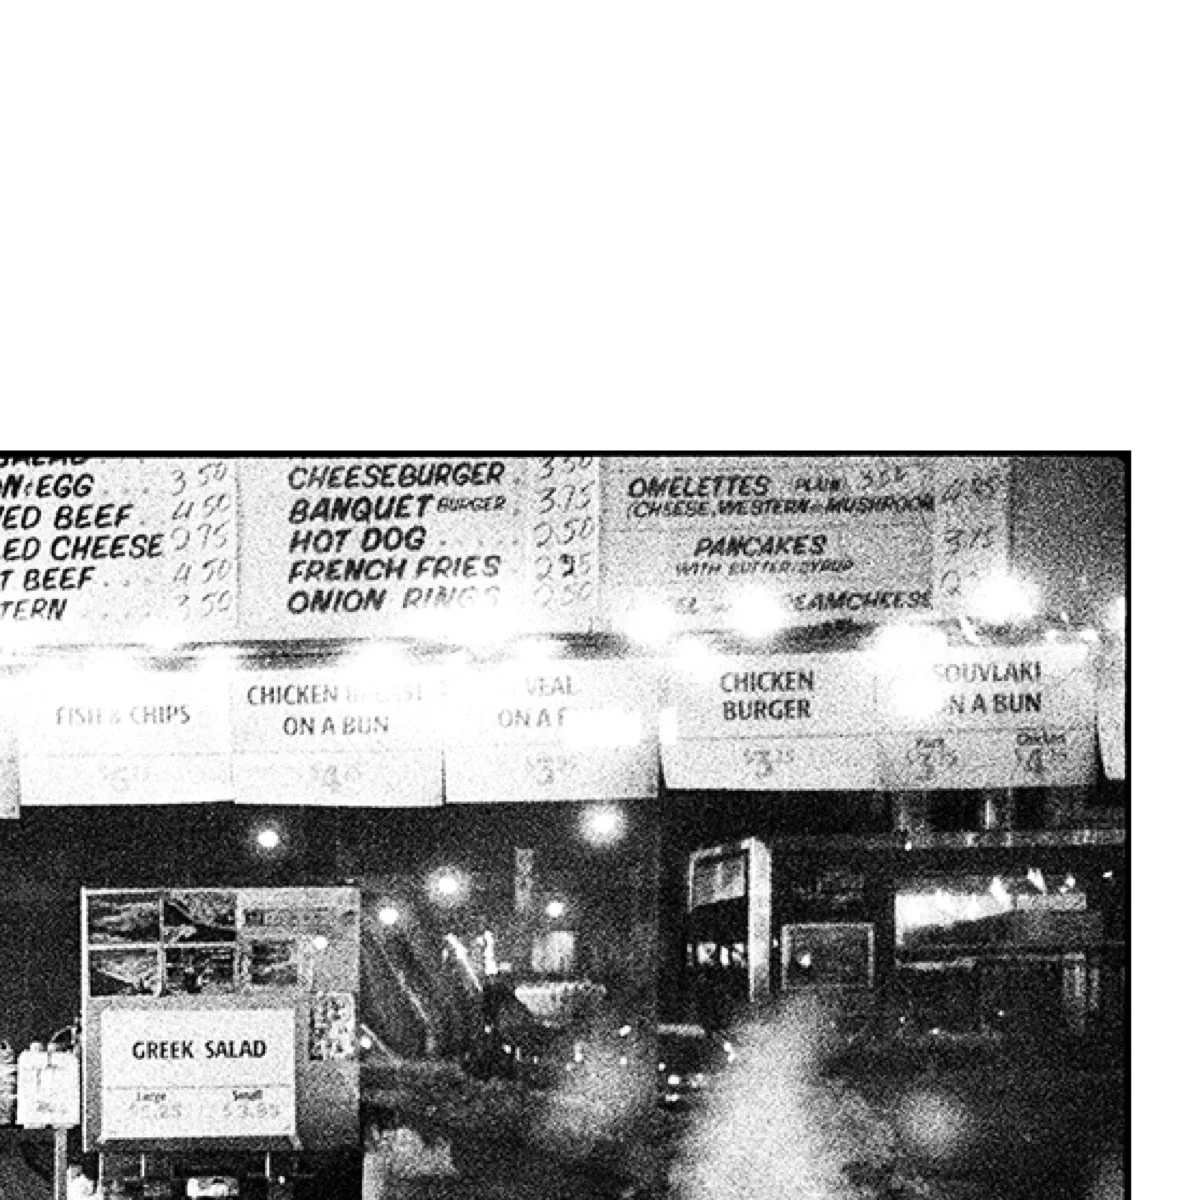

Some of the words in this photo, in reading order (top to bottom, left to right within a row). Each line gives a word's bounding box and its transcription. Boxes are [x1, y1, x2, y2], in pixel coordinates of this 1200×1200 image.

[35, 472, 95, 499] EGG
[288, 461, 505, 490] CHEESEBURGER
[627, 475, 772, 498] OMELETTES
[53, 503, 134, 530] BEEF
[288, 494, 435, 524] BANQUET
[437, 496, 507, 513] BURGER
[50, 533, 165, 561] CHEESE
[289, 528, 353, 553] HOT
[361, 526, 428, 553] DOG
[693, 534, 828, 556] PANCAKES
[23, 566, 96, 592] BEEF
[288, 557, 407, 584] FRENCH
[415, 555, 502, 578] FRIES
[287, 588, 386, 616] ONION
[720, 669, 814, 693] CHICKEN
[247, 684, 338, 706] CHICKEN
[971, 693, 986, 715] A
[993, 692, 1041, 714] BUN
[56, 705, 102, 725] FISH
[128, 704, 192, 724] CHIPS
[497, 709, 531, 728] ON
[536, 708, 552, 728] A
[723, 699, 811, 721] BURGER
[282, 716, 316, 736] ON
[320, 716, 337, 736] A
[342, 715, 390, 735] BUN
[132, 1039, 194, 1060] GREEK
[204, 1039, 267, 1059] SALAD
